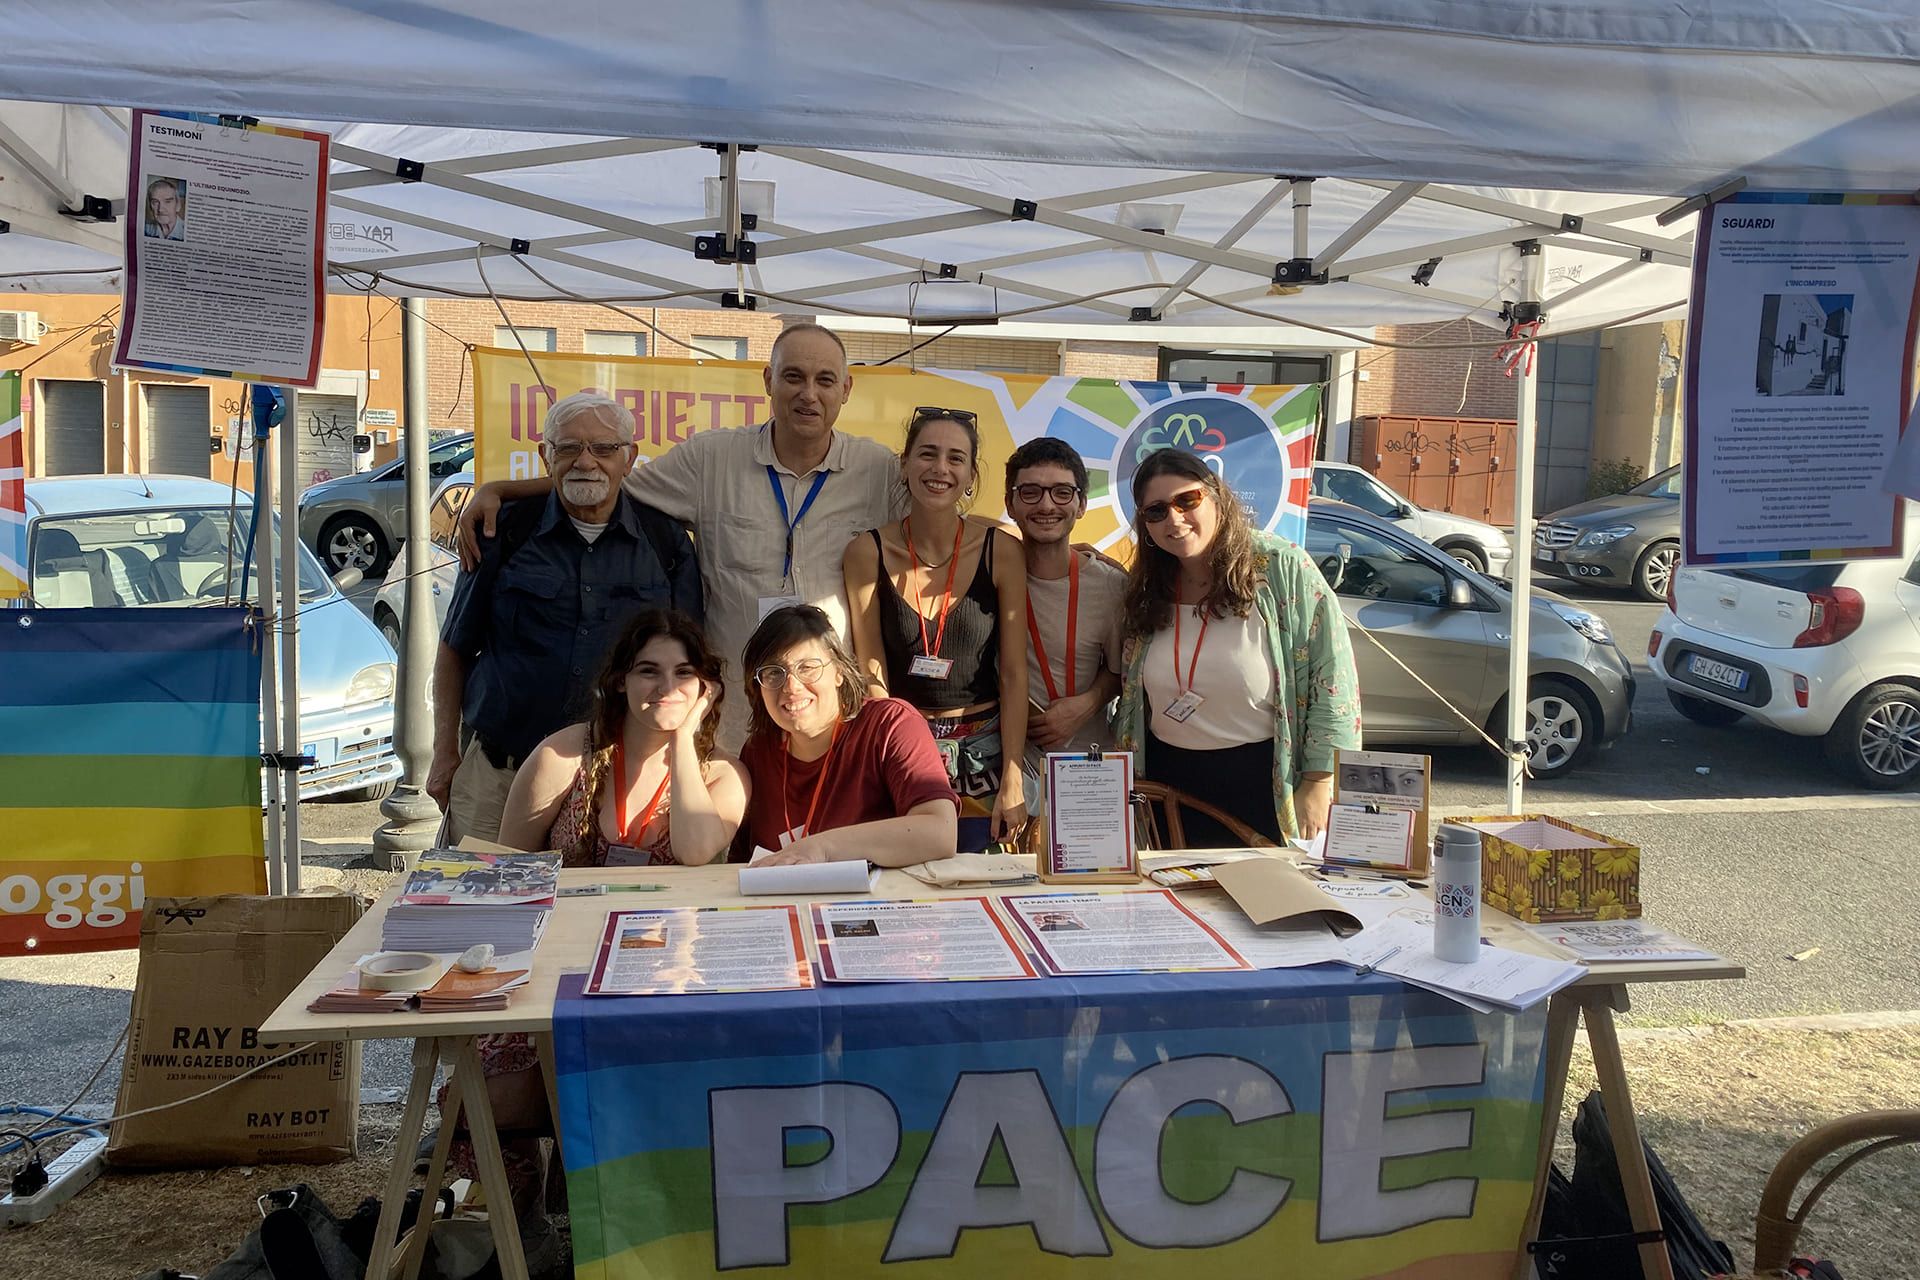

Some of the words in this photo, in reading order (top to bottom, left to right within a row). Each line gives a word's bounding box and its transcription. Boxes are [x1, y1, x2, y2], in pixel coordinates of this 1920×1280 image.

[150, 125, 202, 141] TESTIMONI
[1721, 218, 1775, 229] SGUARDI
[172, 1027, 232, 1049] RAY
[247, 1112, 285, 1128] RAY
[291, 1108, 330, 1126] BOT
[706, 1041, 1488, 1273] PACE
